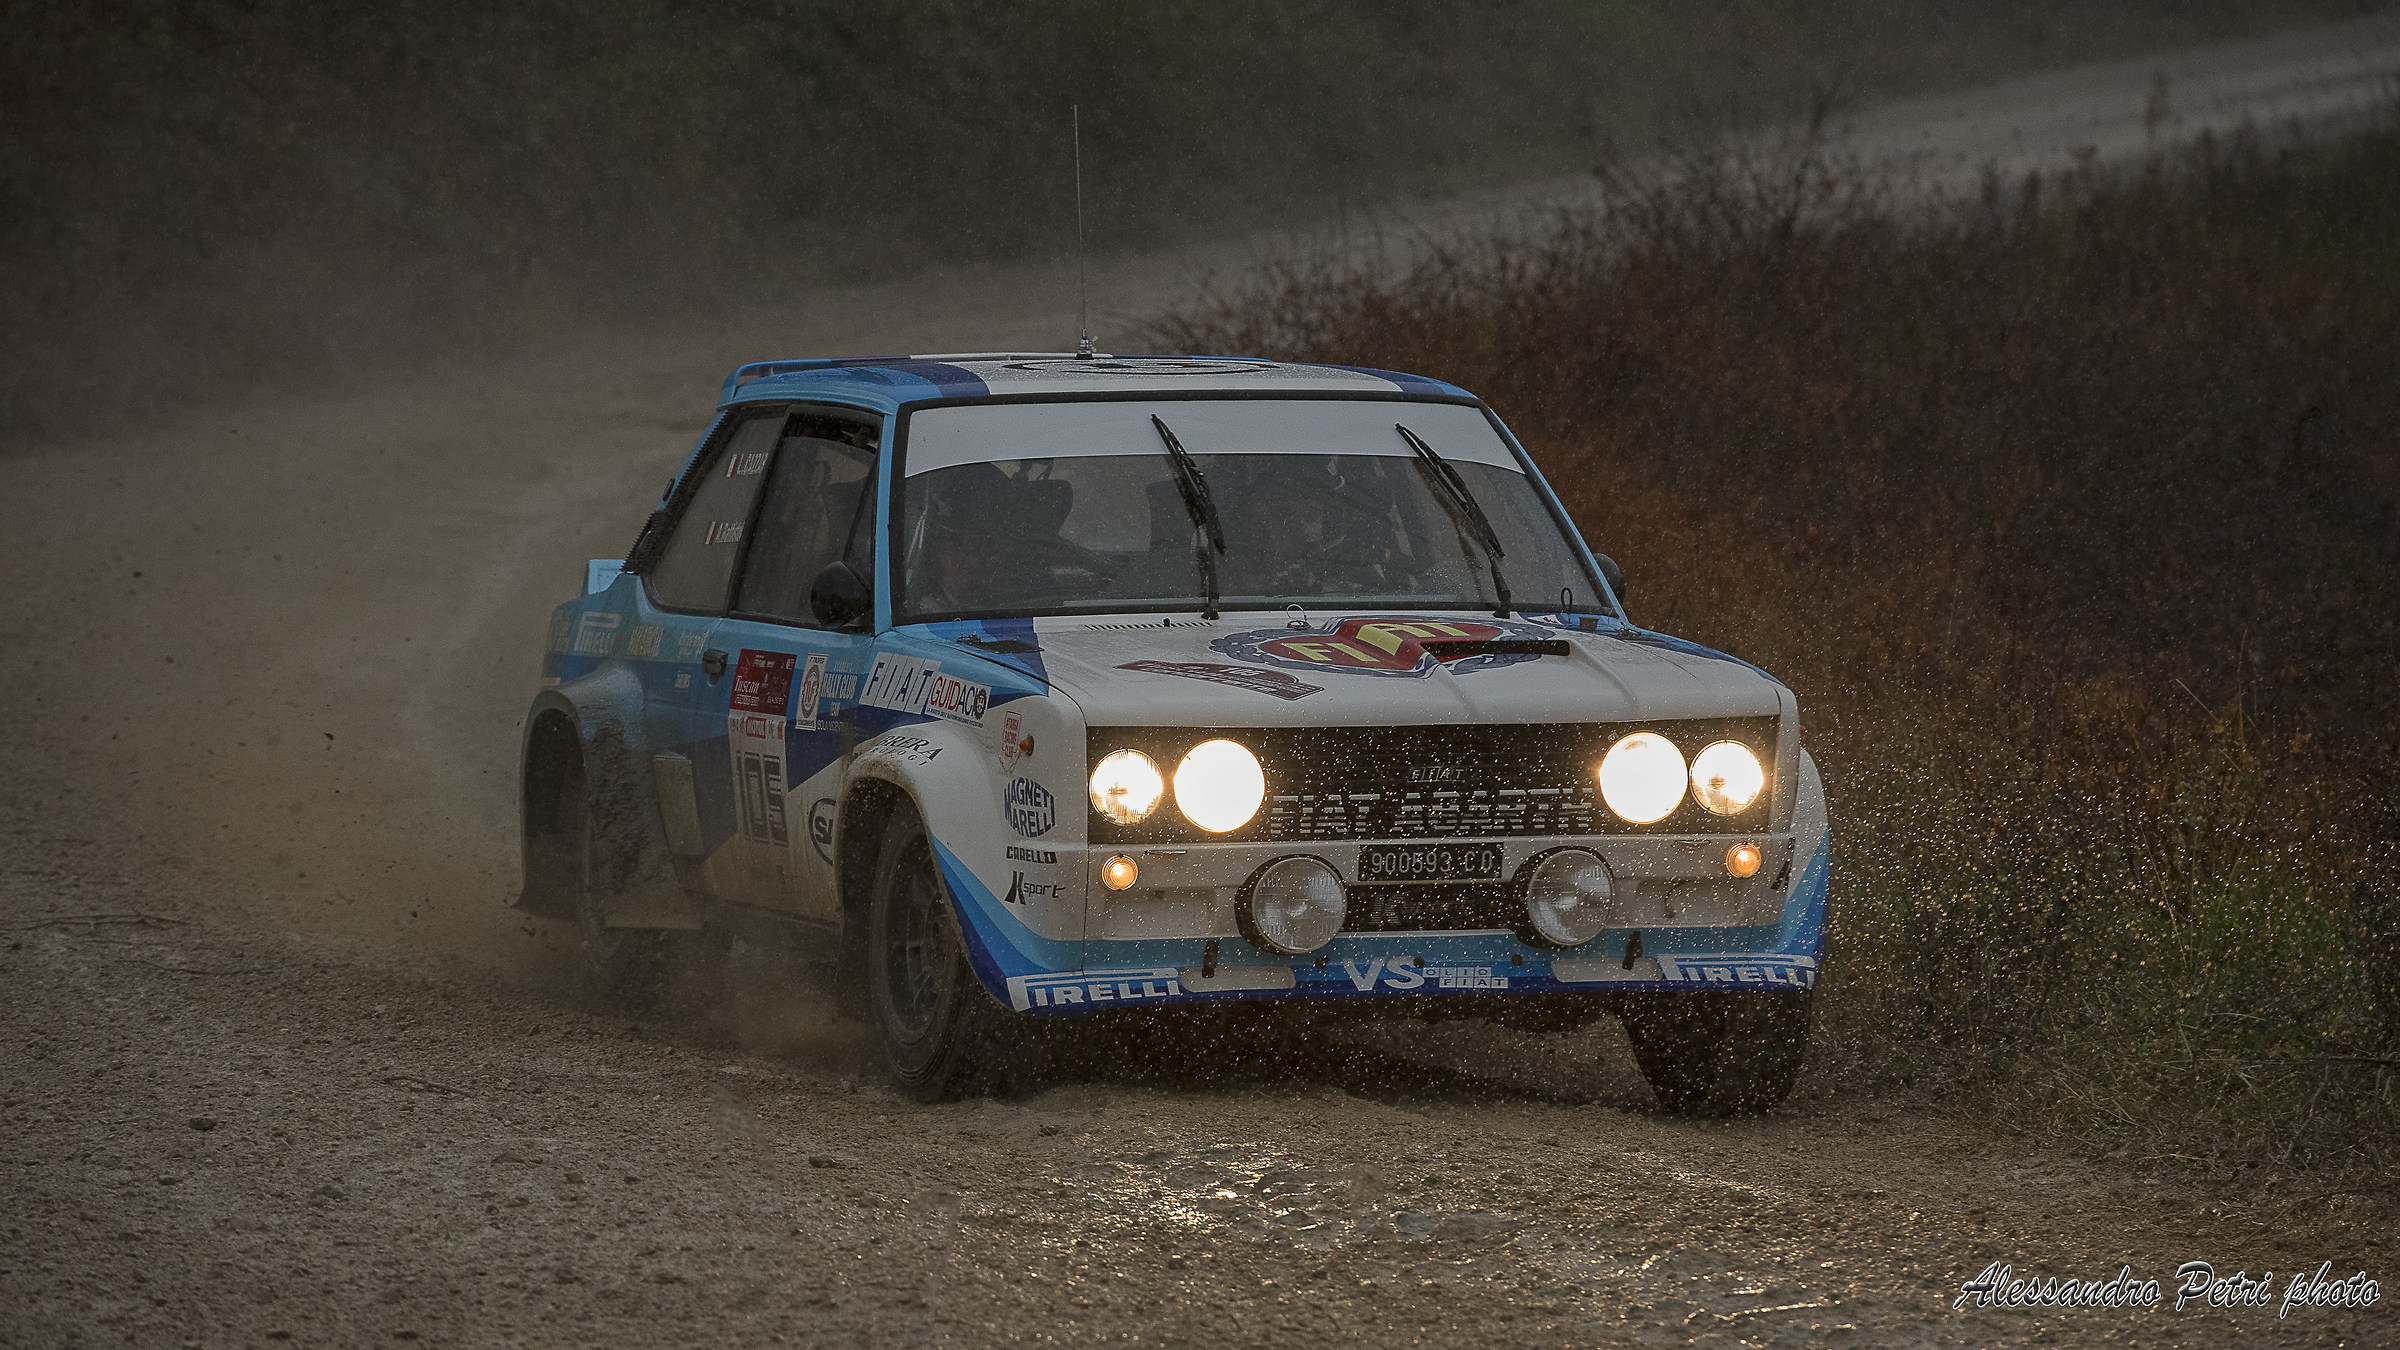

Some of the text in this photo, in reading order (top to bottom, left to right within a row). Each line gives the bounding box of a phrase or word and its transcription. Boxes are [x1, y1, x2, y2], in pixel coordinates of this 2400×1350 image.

[1280, 622, 1470, 662] FIAT
[734, 675, 760, 694] Tuscan
[821, 673, 841, 698] RALLY
[840, 674, 858, 699] CLUB
[866, 662, 934, 704] FIAT
[875, 735, 943, 761] BRERA
[1411, 768, 1465, 781] FIAT
[1004, 777, 1055, 811] MAGNETI
[1004, 806, 1056, 838] MARELLI
[1270, 787, 1593, 834] FIAT ABARTH
[1006, 846, 1058, 864] CARELLO
[1371, 851, 1451, 874] 900593
[1341, 957, 1427, 991] VS
[1424, 967, 1490, 977] OLIO
[1445, 978, 1505, 988] FIAT
[1657, 953, 1816, 990] PIRELLI
[1006, 967, 1178, 1011] PIRELLI
